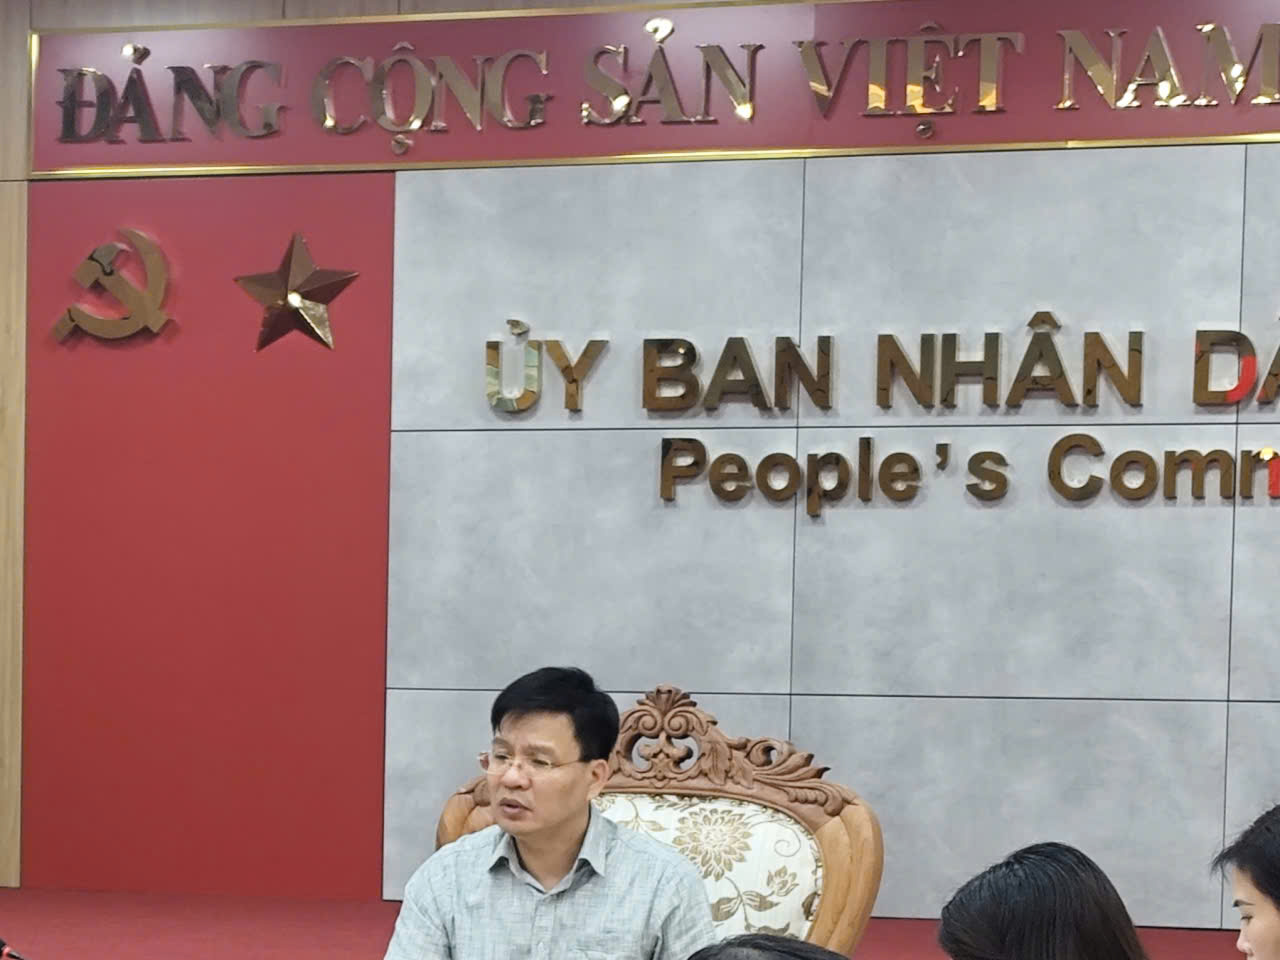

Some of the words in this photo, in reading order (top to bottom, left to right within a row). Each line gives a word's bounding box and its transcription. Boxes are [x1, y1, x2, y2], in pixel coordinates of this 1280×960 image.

[56, 44, 288, 143] ĐẢNG
[317, 41, 552, 155] CỘNG
[581, 17, 764, 127] SẢN
[792, 22, 1024, 138] VIỆT
[1054, 22, 1280, 111] NAM
[485, 318, 609, 413] ỦY
[642, 334, 835, 412] BAN
[875, 311, 1144, 411] NHÂN
